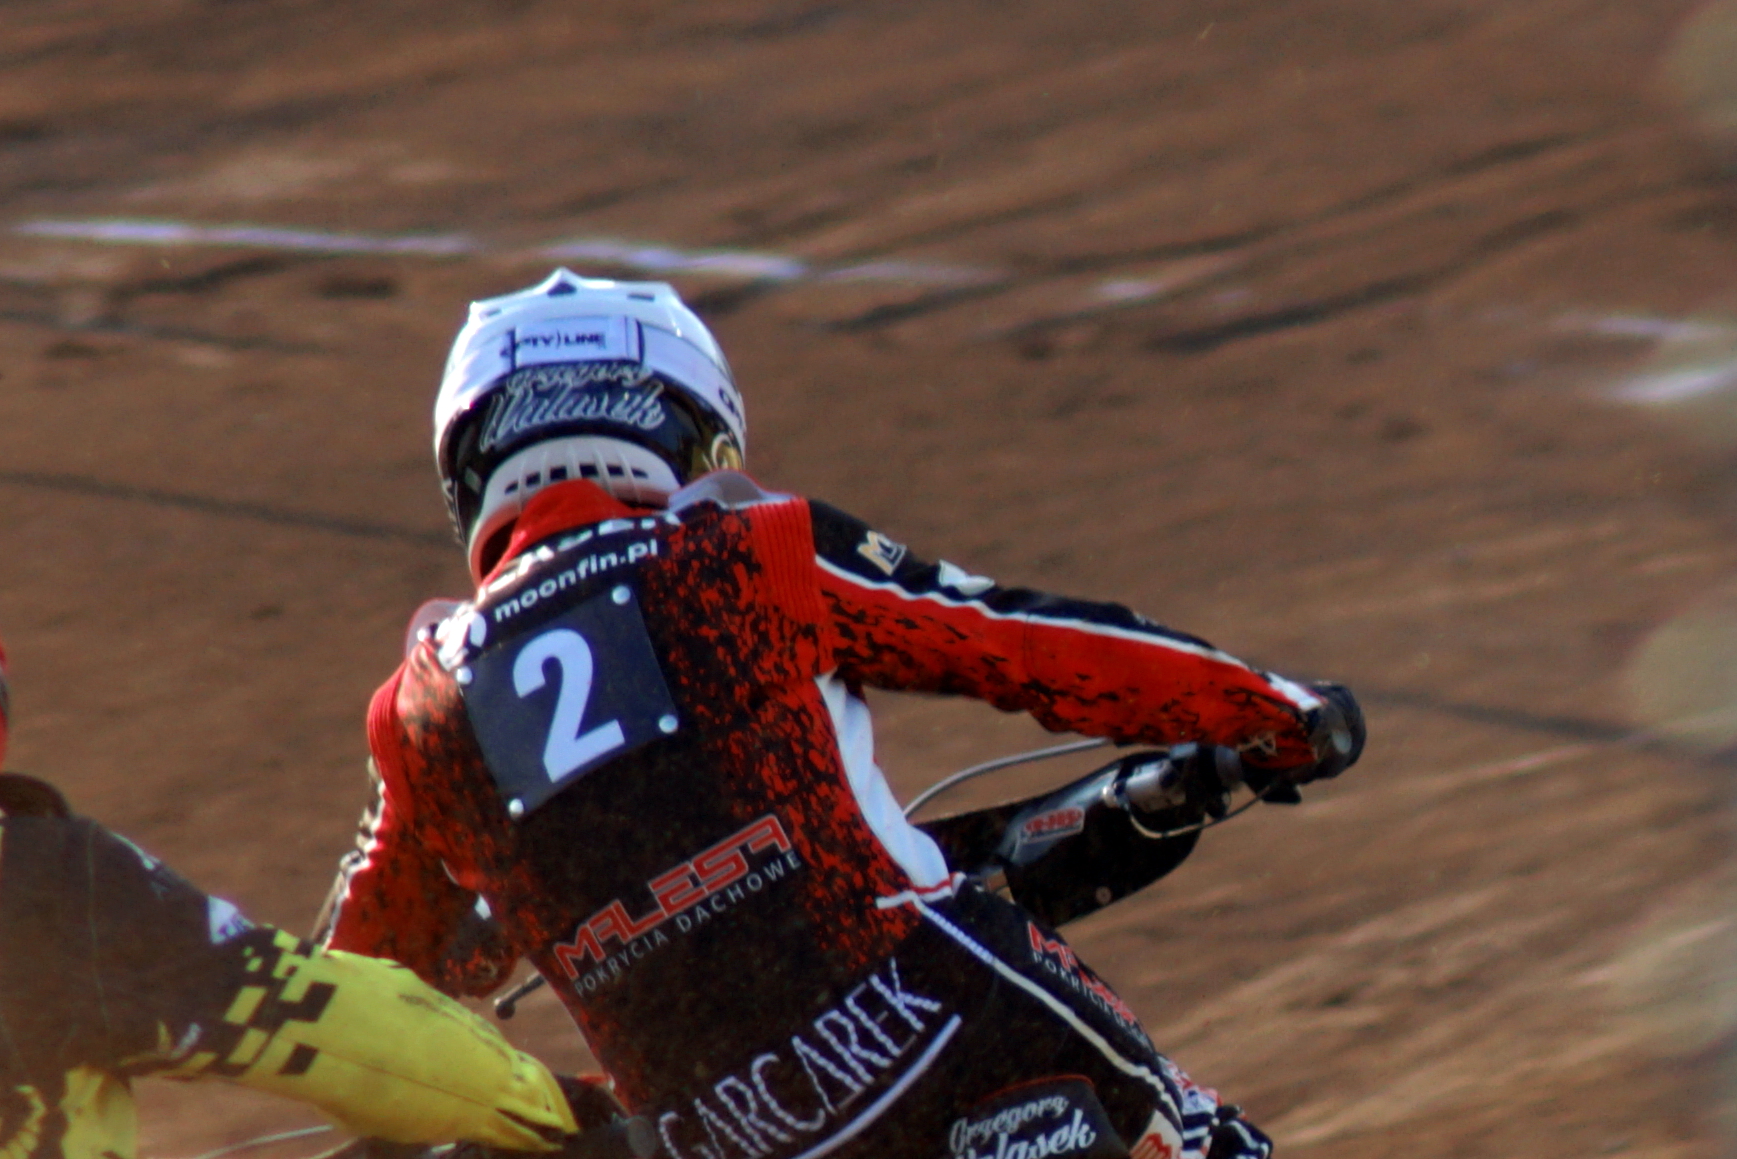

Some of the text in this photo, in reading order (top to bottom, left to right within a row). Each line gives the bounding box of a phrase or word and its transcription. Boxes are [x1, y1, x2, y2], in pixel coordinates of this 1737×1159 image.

[494, 538, 659, 622] moonfin.pl
[512, 628, 626, 783] 2
[553, 813, 792, 979] MALESA
[573, 851, 802, 998] POKRYCIA DACHOWE
